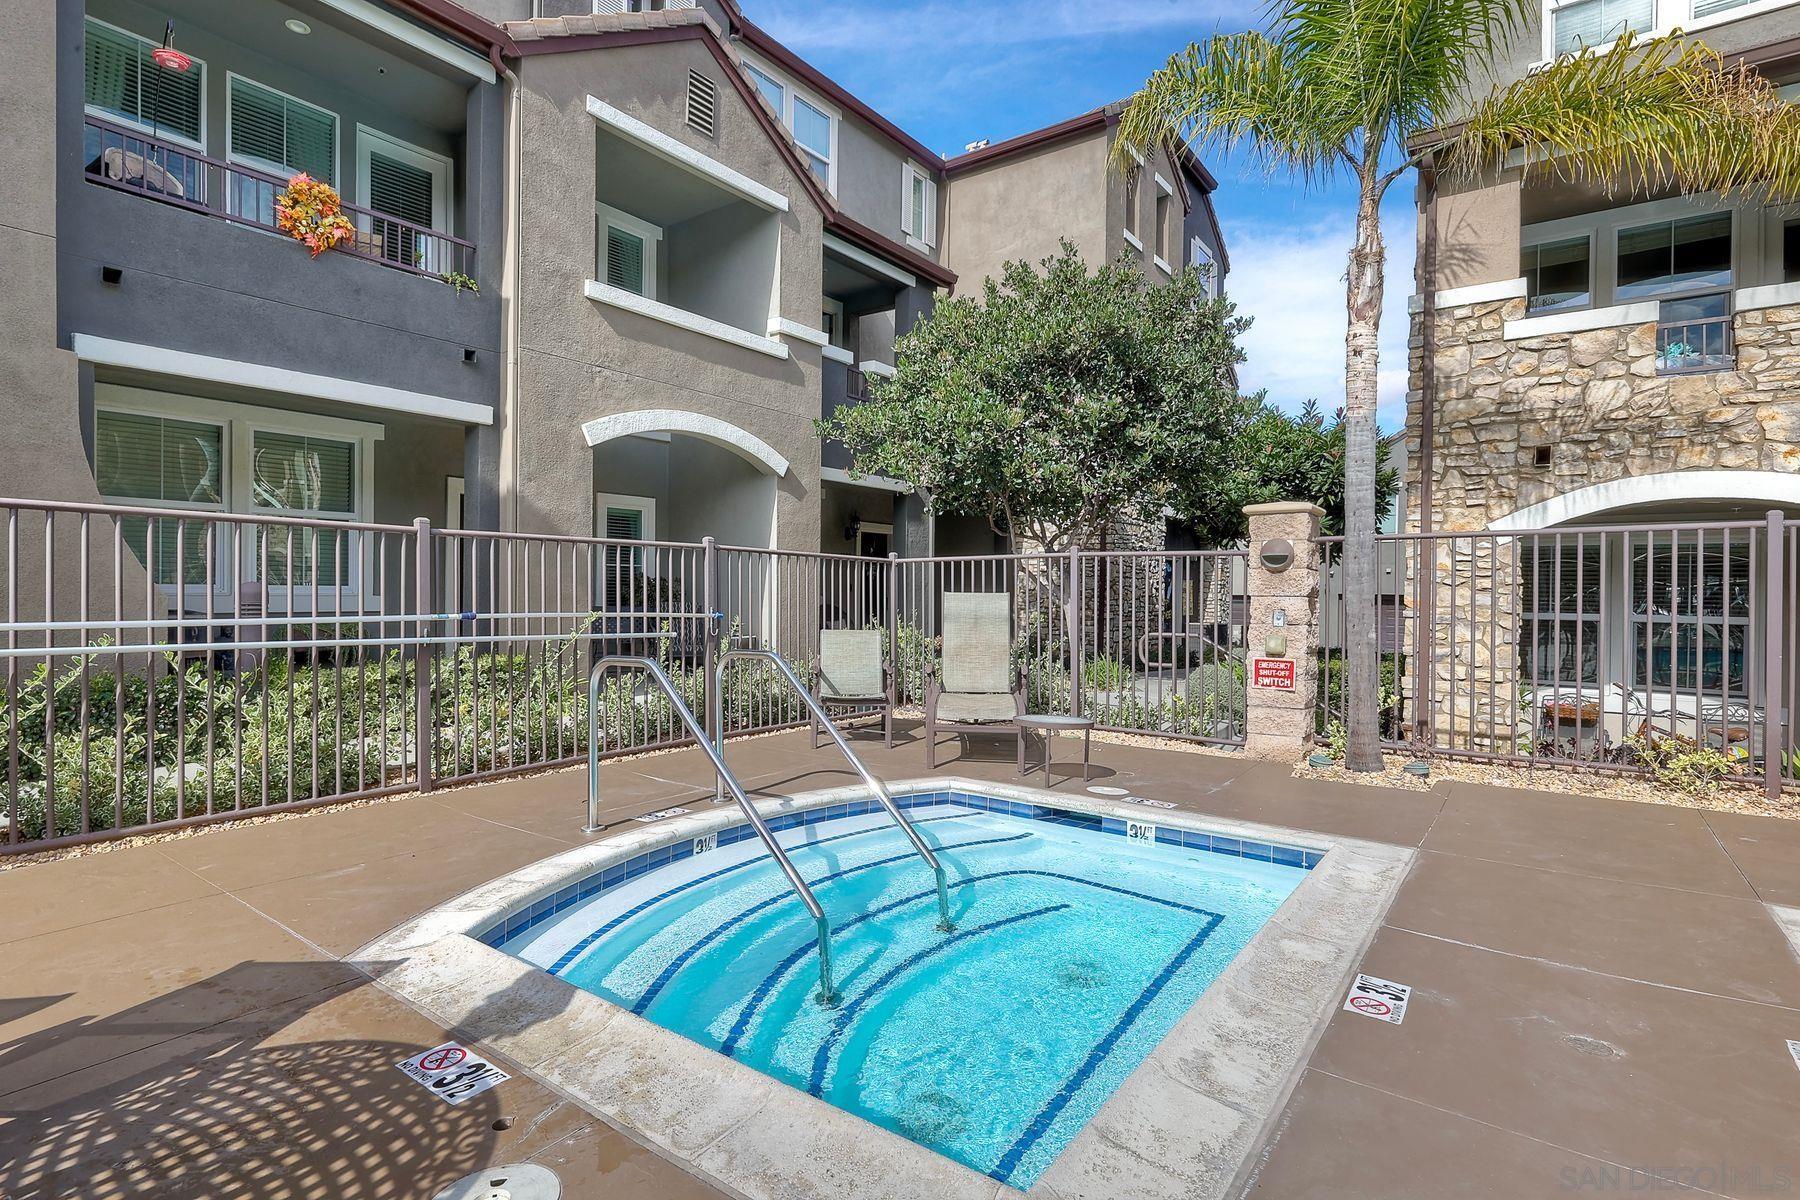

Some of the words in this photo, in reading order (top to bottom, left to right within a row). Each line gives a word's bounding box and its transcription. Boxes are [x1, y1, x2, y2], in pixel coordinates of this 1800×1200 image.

[1258, 661, 1291, 670] EMERGENCY
[1258, 669, 1290, 677] SHUT-OFF
[1257, 676, 1291, 687] SWITCH
